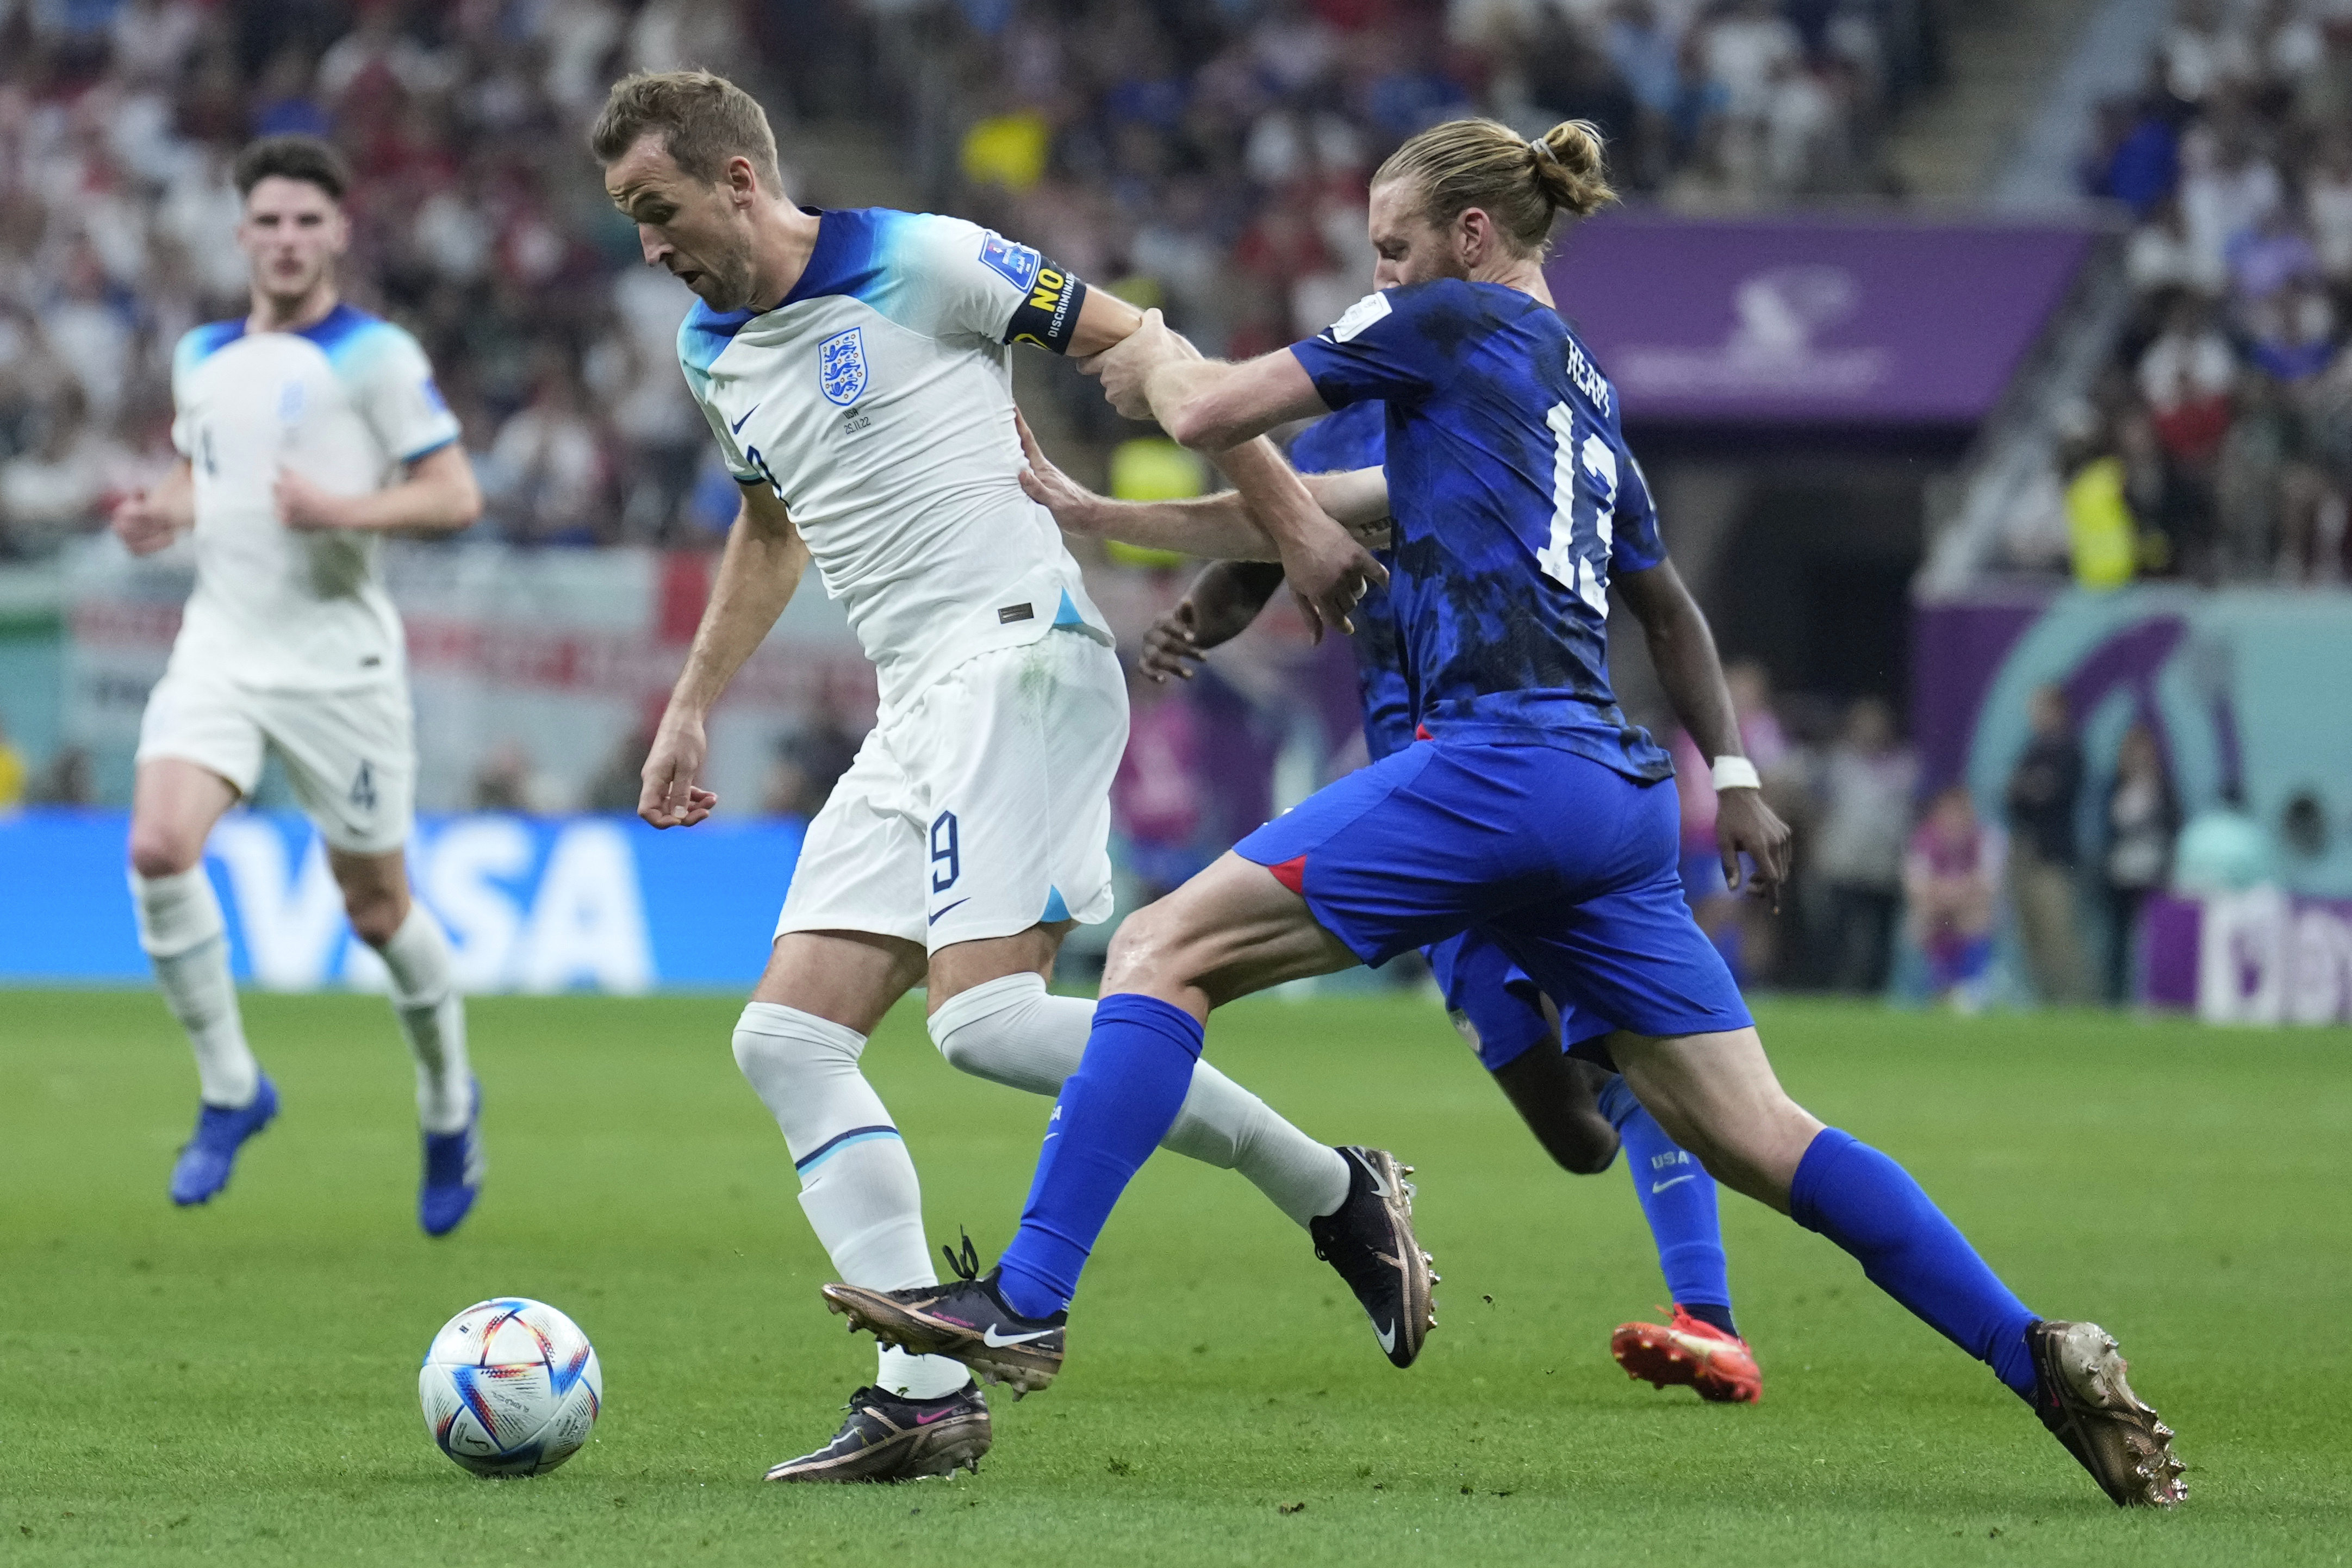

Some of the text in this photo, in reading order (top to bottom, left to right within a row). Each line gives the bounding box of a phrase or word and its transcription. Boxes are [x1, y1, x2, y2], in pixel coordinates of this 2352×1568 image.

[1029, 269, 1064, 312] NO
[843, 408, 858, 419] USA
[844, 416, 871, 434] 25.11.22
[351, 759, 376, 811] 4
[930, 810, 960, 894] 9
[1651, 1150, 1690, 1169] USA
